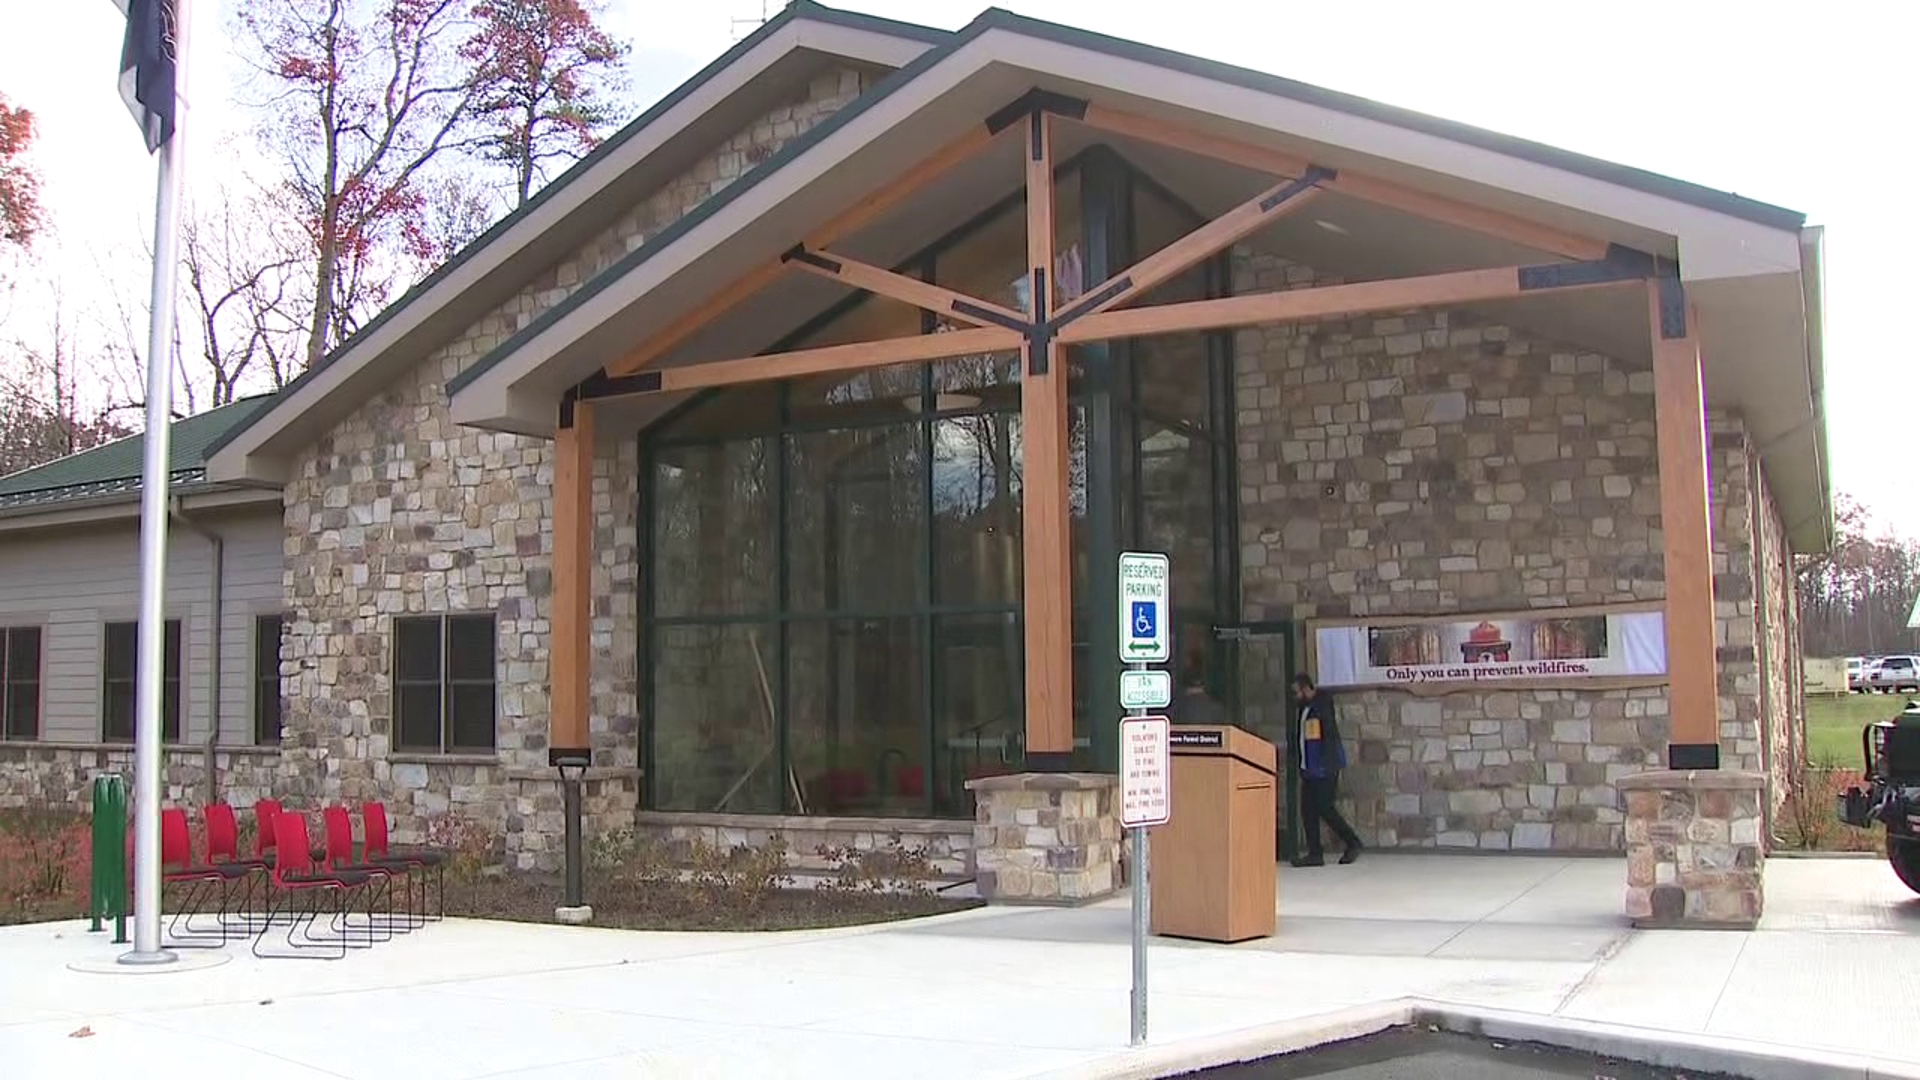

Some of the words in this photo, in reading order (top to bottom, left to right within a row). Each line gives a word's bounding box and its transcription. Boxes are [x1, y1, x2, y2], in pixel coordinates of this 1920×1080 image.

[1124, 563, 1163, 579] RESERVED
[1126, 583, 1162, 597] PARKING
[1387, 667, 1416, 683] Only
[1420, 669, 1444, 683] you
[1447, 668, 1470, 678] can
[1474, 665, 1524, 680] prevent
[1527, 662, 1589, 675] wildfires.
[1127, 690, 1164, 701] ACCESSIBLE
